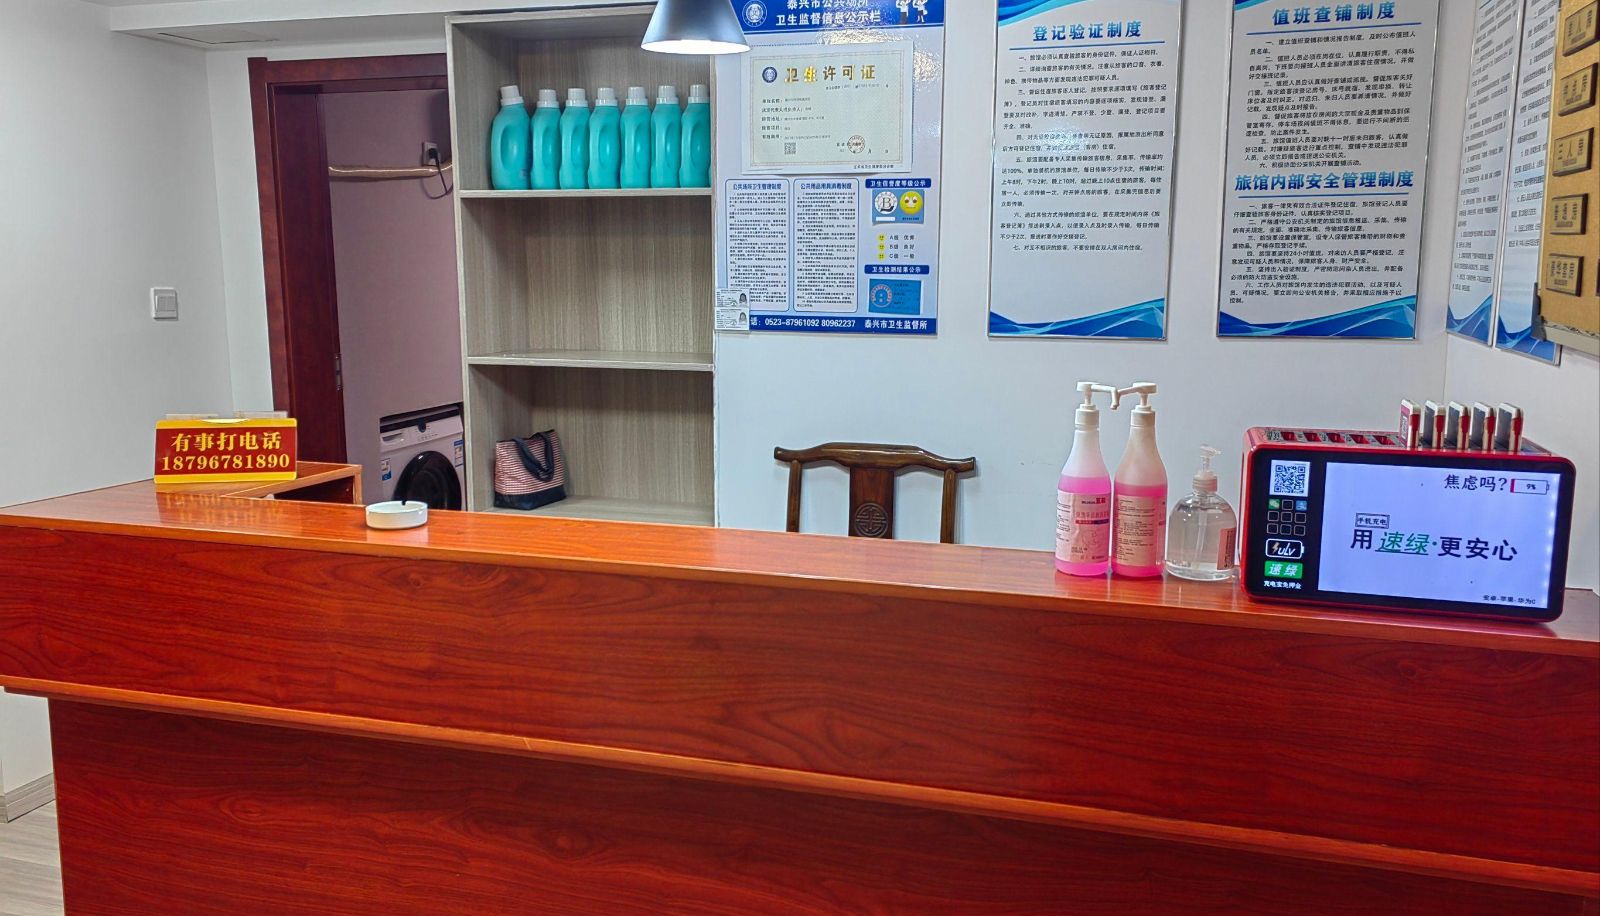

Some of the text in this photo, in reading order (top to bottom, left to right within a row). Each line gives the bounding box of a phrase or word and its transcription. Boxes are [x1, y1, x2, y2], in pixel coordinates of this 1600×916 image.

[776, 9, 880, 25] 卫生监督信息公示栏
[1272, 2, 1396, 26] 值班查铺制度
[1032, 20, 1142, 41] 登记验证制度
[784, 65, 876, 82] 卫生许可证
[1235, 170, 1414, 191] 旅馆内部安全管理制度
[765, 318, 819, 326] 0523-87961092
[865, 320, 927, 330] 泰兴市卫生监督所
[171, 432, 281, 451] 有事打电话
[161, 454, 290, 470] 18796781890
[1269, 563, 1298, 576] 速绿
